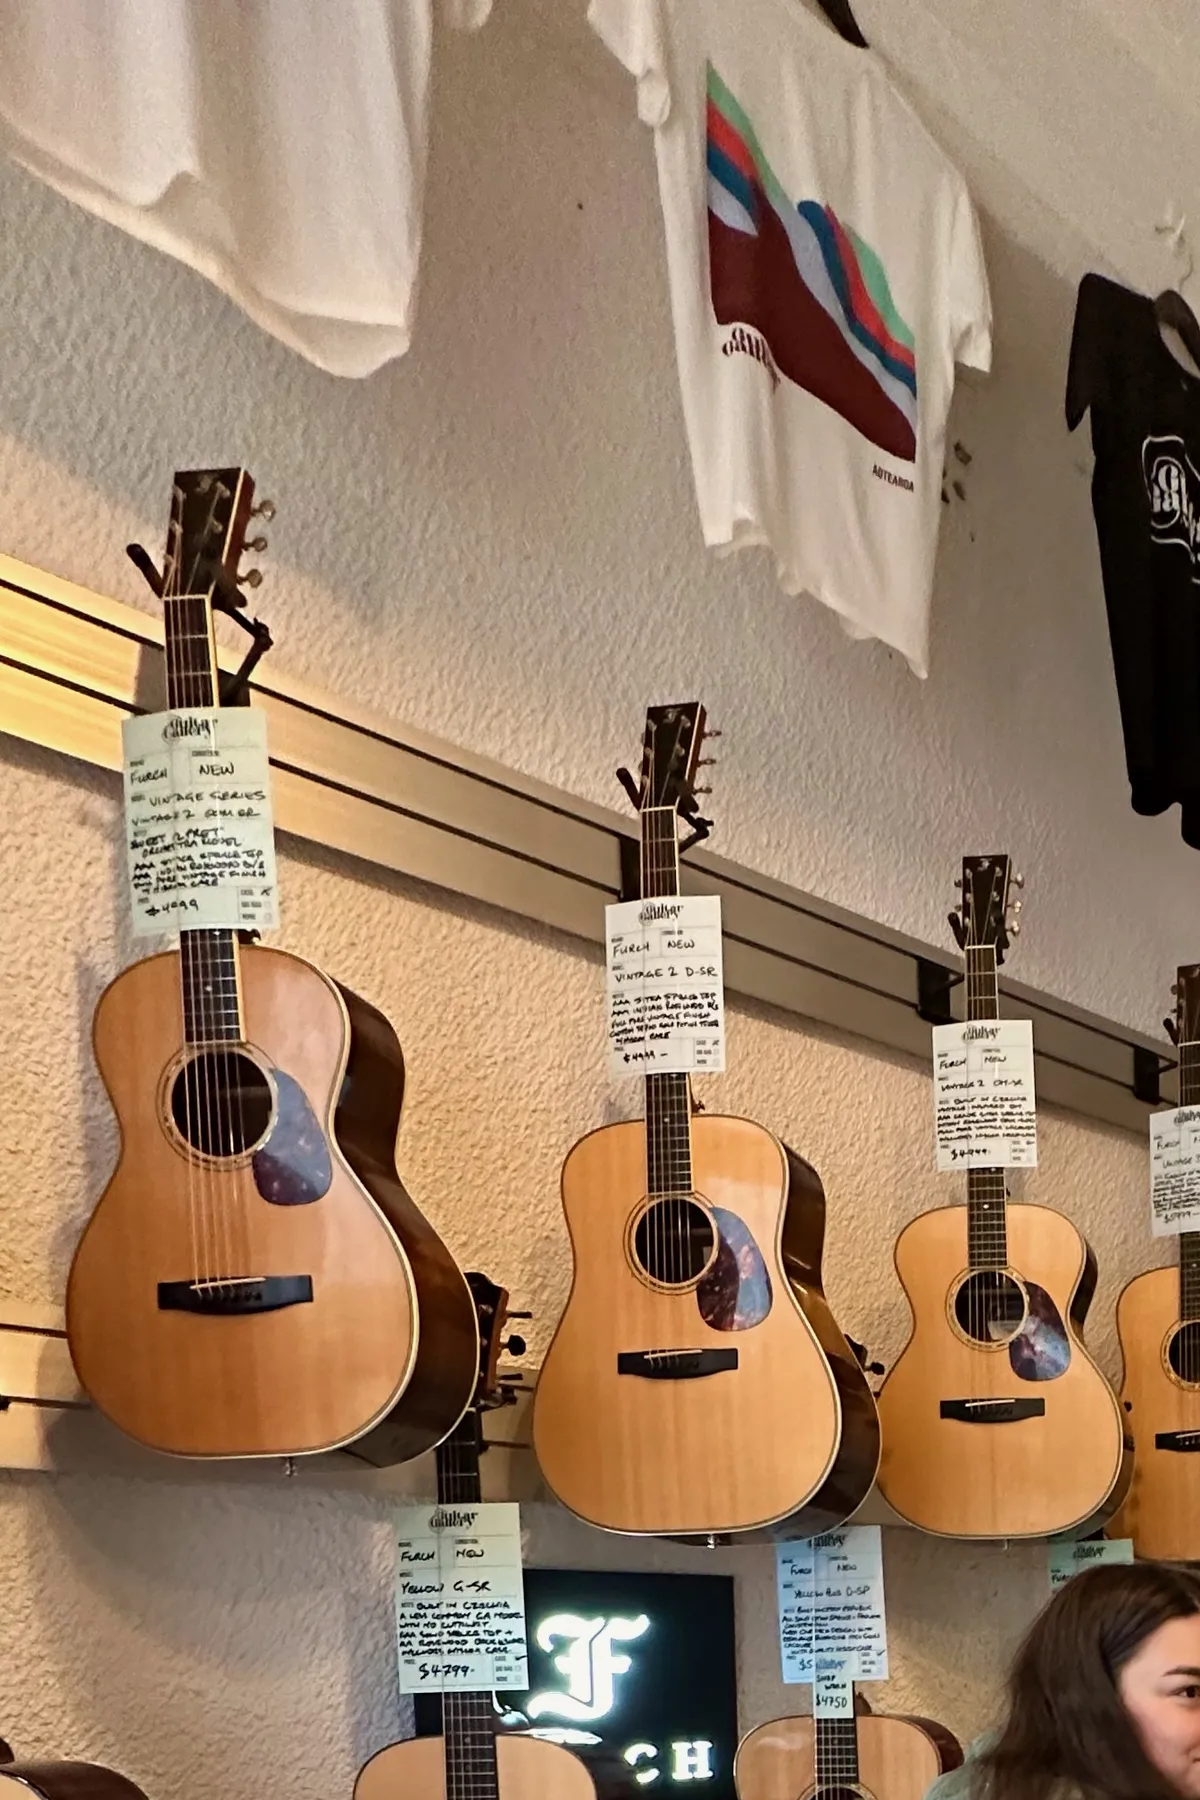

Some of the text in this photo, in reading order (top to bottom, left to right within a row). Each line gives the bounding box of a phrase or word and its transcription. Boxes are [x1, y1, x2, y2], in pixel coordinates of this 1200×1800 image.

[199, 764, 235, 776] NEW
[613, 943, 649, 957] FURCH
[667, 939, 695, 949] NEW
[615, 968, 663, 982] VINTAGE
[668, 967, 678, 976] 2
[456, 1549, 485, 1558] NEW
[402, 1582, 444, 1594] YELLOW
